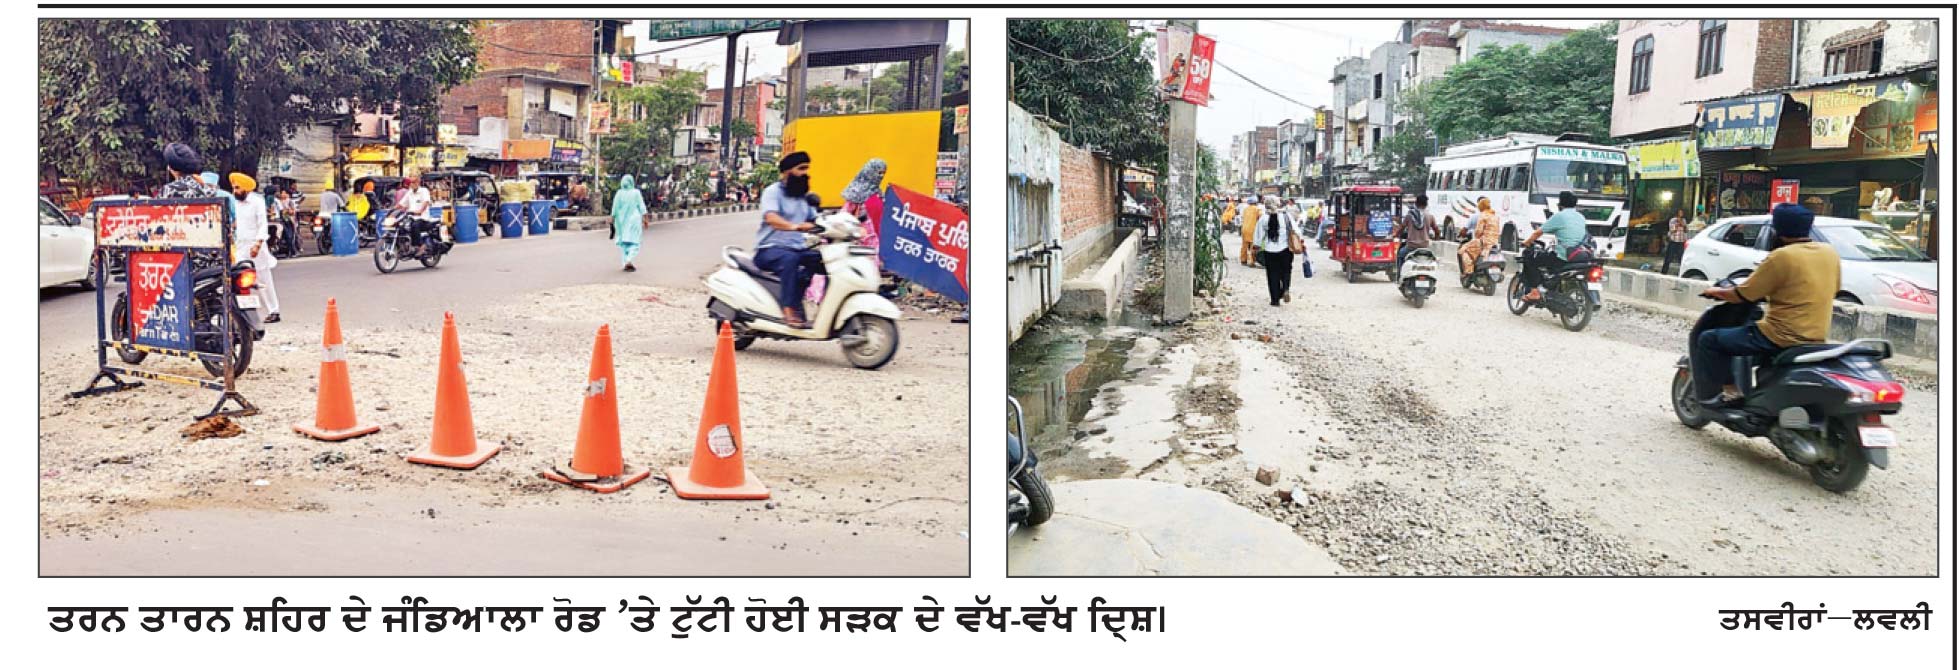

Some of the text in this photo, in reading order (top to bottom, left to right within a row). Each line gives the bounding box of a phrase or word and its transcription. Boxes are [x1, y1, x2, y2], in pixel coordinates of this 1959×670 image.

[1190, 54, 1210, 79] 58
[891, 202, 937, 237] ਪੰਜਾਬ
[893, 236, 960, 273] ਤਰਨ ਤਾਰਨ
